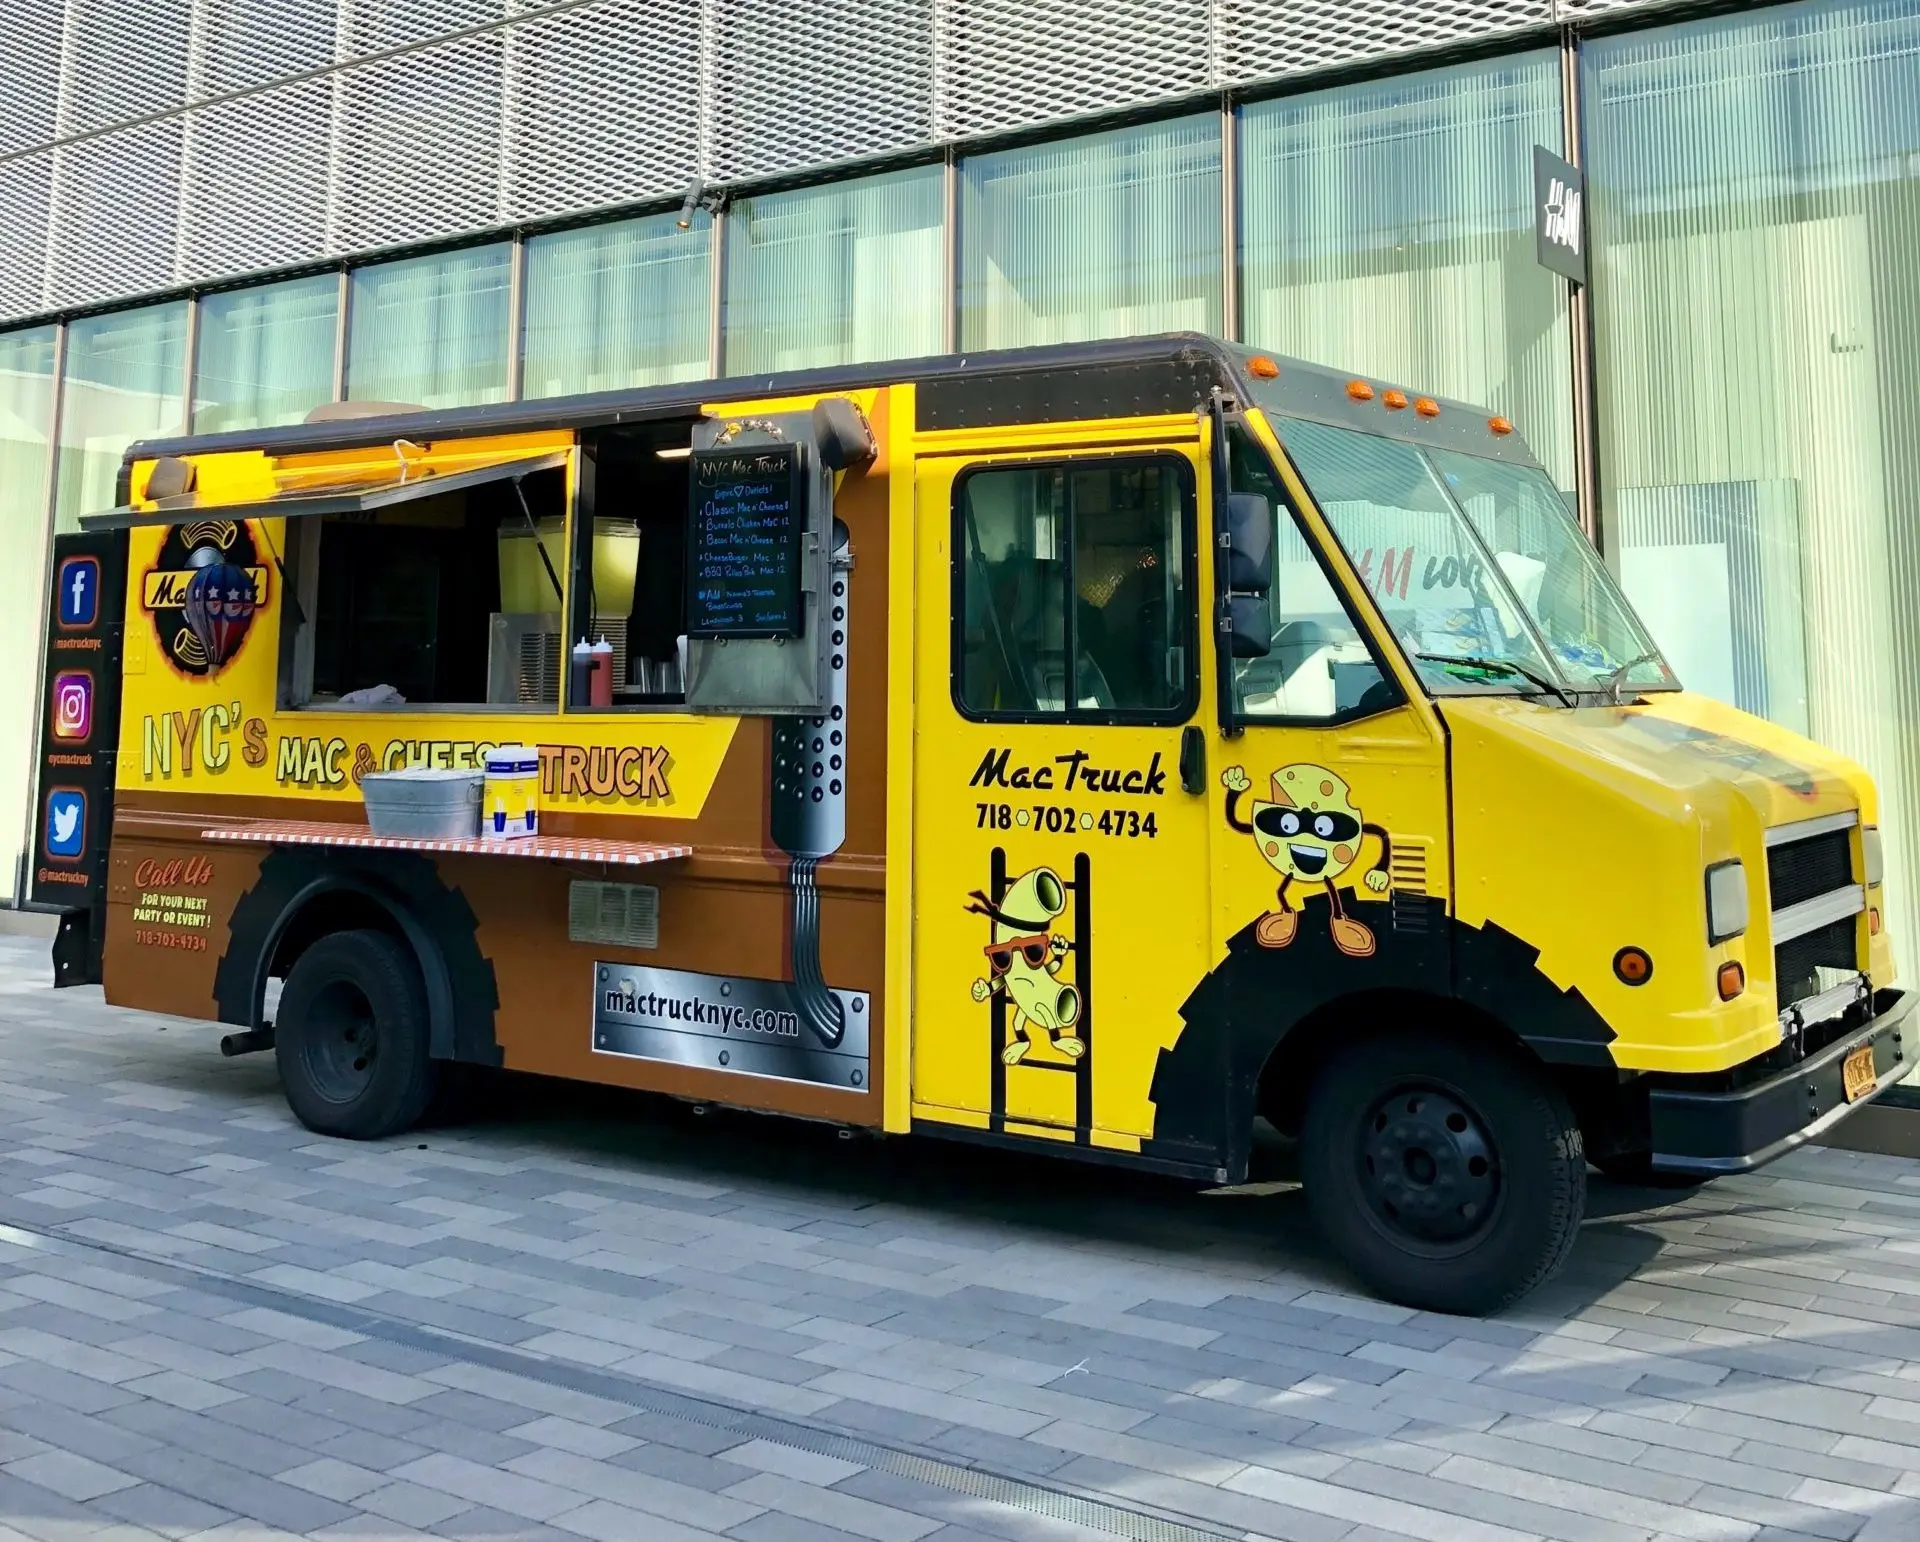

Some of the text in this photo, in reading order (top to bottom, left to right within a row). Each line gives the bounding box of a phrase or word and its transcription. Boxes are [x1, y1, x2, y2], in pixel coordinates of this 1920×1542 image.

[1544, 177, 1581, 256] H&M
[702, 461, 728, 479] NYC
[276, 736, 346, 784] MAC
[536, 744, 670, 798] TRUCK
[976, 803, 1158, 838] 718 702 4734
[134, 855, 214, 889] Call Us
[133, 908, 162, 922] PARTY
[163, 912, 176, 924] OR
[141, 893, 207, 911] FOR YOUR NEXT
[605, 990, 799, 1036] mactrucknyc.com
